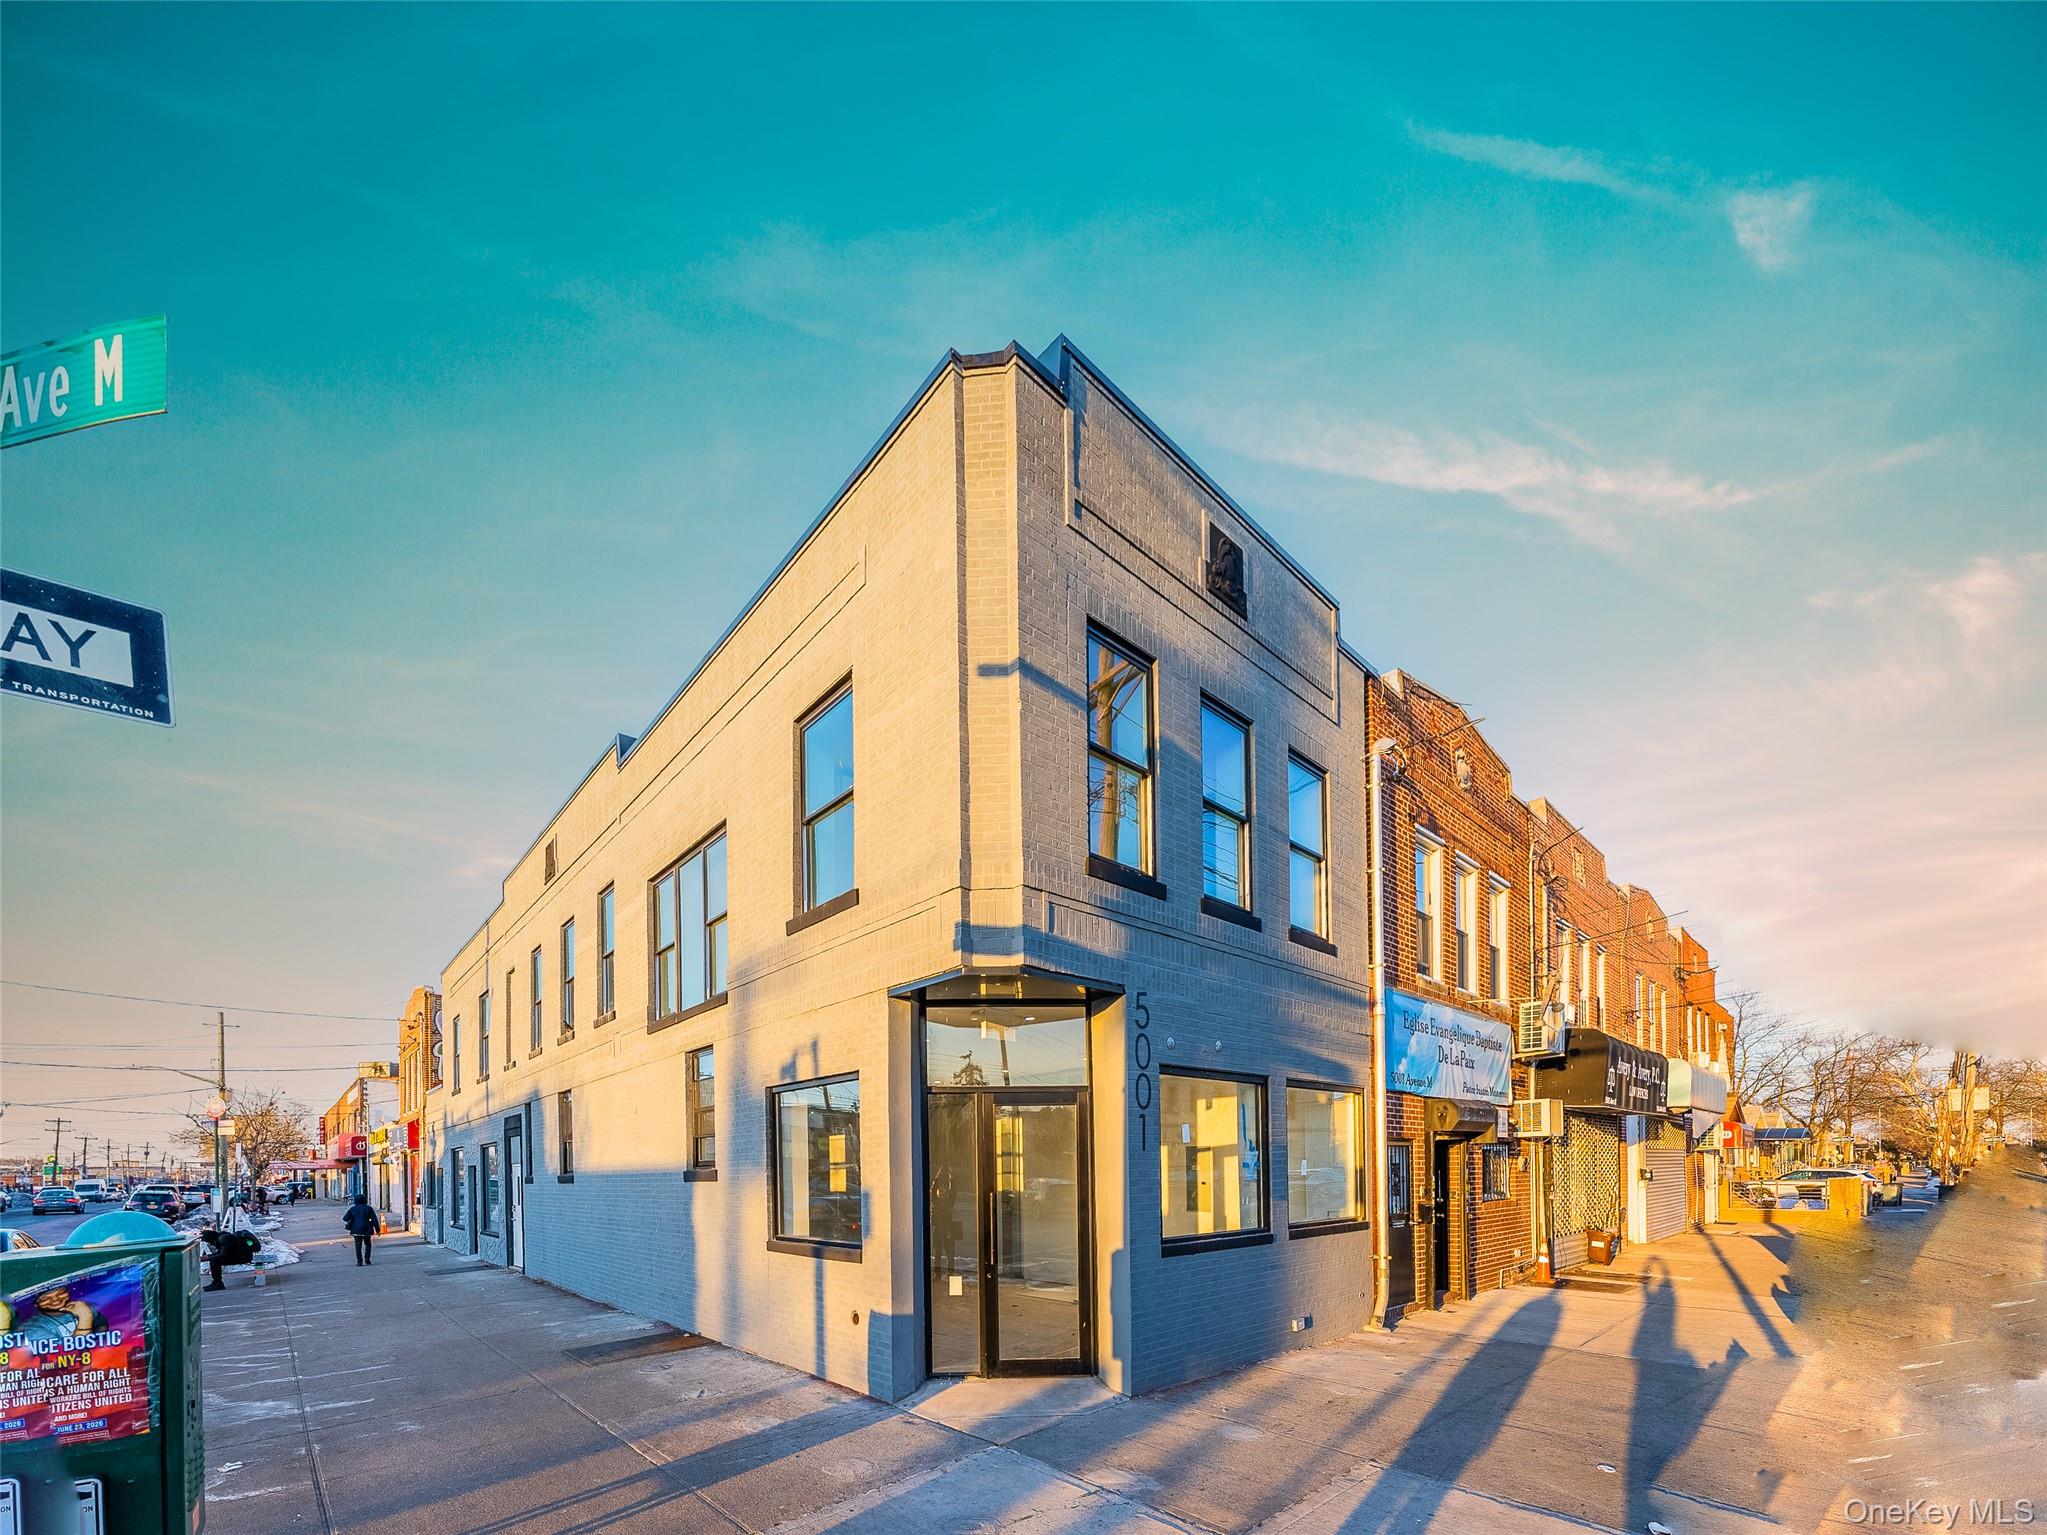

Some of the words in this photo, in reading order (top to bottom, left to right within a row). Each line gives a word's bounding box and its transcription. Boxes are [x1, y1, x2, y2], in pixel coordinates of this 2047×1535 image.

[0, 365, 70, 432] Ave
[94, 334, 123, 406] M
[1, 611, 97, 669] AY
[12, 681, 154, 719] TRANSPORTATION
[1475, 1030, 1503, 1053] Baptiste
[1438, 1045, 1449, 1065] De
[1450, 1047, 1460, 1066] La
[1460, 1050, 1475, 1070] Paix
[1135, 991, 1151, 1151] 5001
[1632, 1060, 1637, 1078] &
[63, 1330, 121, 1352] BOSTIC
[57, 1351, 91, 1368] NY-8
[0, 1370, 23, 1383] FOR
[82, 1370, 105, 1383] FOR
[108, 1367, 131, 1380] ALL
[50, 1394, 82, 1403] WORKERS
[82, 1391, 97, 1400] BILL
[108, 1386, 132, 1395] RIGHTS
[57, 1387, 65, 1396] A
[67, 1382, 101, 1394] HUMAN
[103, 1378, 131, 1390] RIGHT
[95, 1393, 132, 1407] UNITED
[4, 1420, 21, 1429] 2026
[57, 1425, 74, 1433] JUNE
[86, 1420, 104, 1428] 2026
